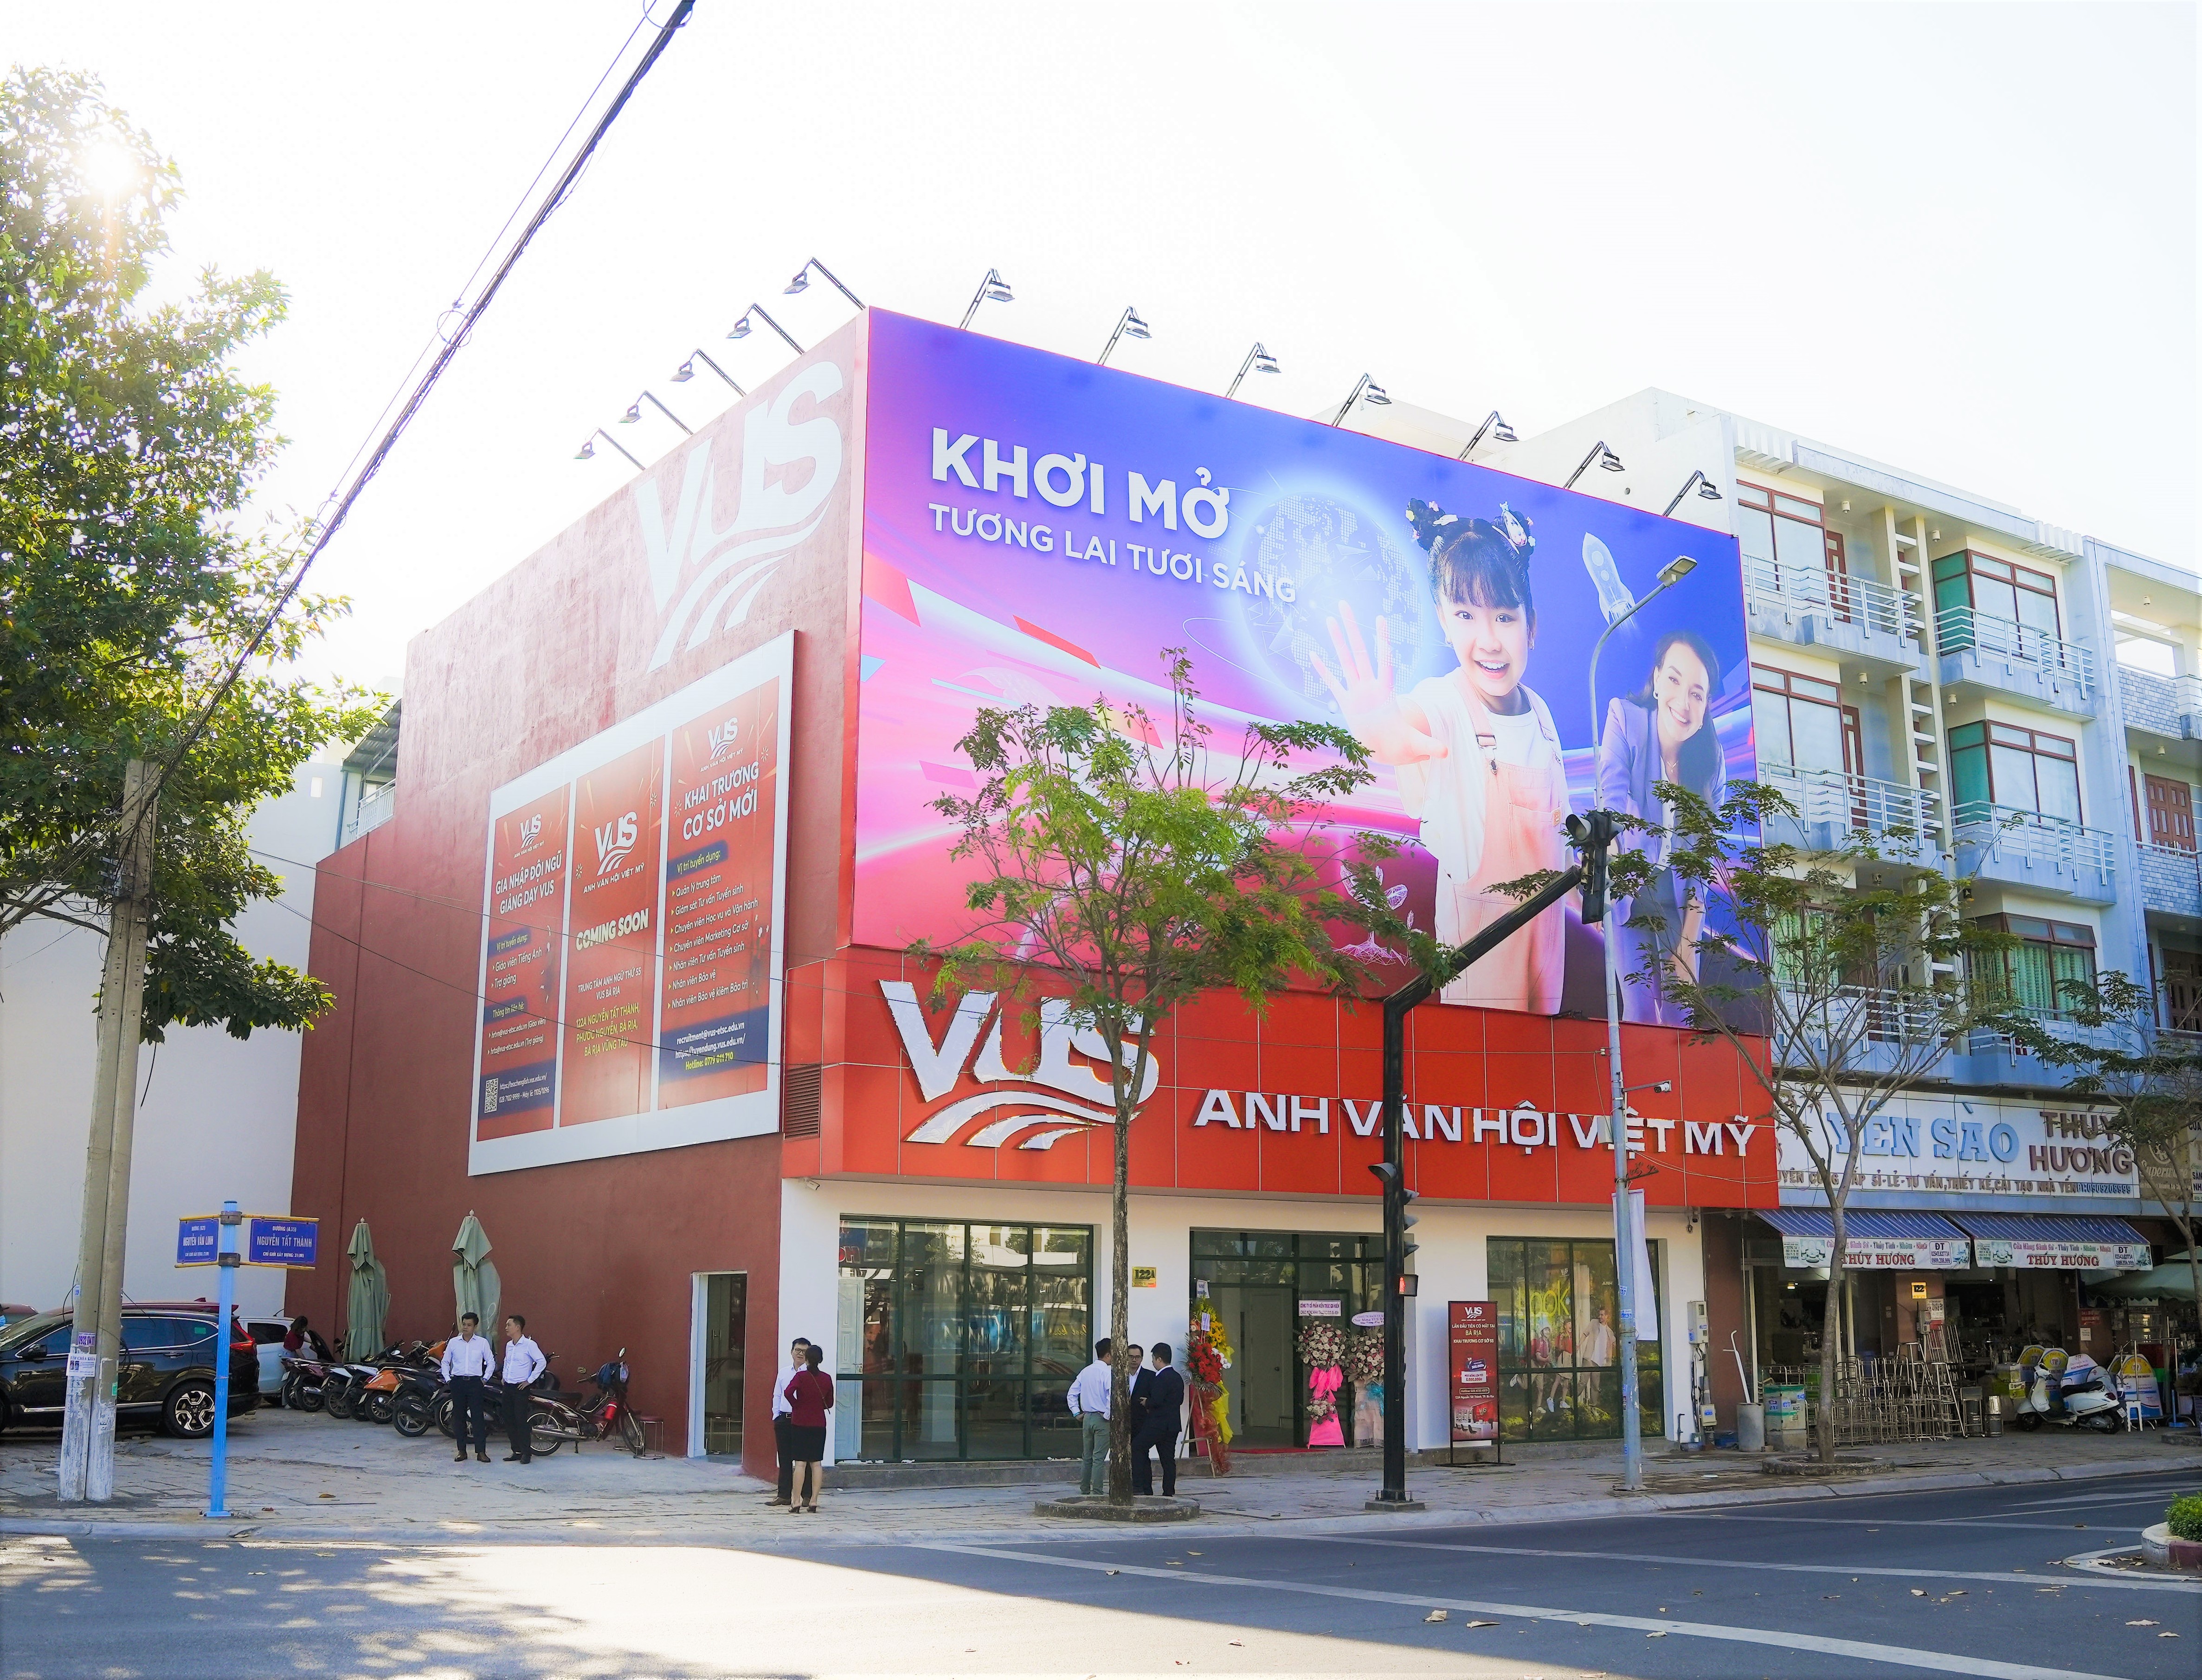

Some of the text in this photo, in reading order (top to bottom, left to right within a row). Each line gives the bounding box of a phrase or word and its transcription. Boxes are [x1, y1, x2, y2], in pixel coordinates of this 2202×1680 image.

[635, 360, 843, 618] VUS
[932, 426, 1230, 540] KHƠI MỞ
[928, 502, 1297, 603] TƯƠNG LAI TƯƠI SÁNG
[708, 717, 738, 752] VUS
[684, 761, 759, 810] KHAI TRƯƠNG
[683, 785, 757, 840] CƠ SỞ MỚI
[594, 811, 638, 863] VUS
[496, 850, 562, 895] GIA NHẬP ĐỘI NGŨ
[677, 864, 682, 874] Vị
[690, 854, 704, 869] tuyển
[706, 850, 721, 863] dụng:
[583, 862, 644, 894] ANH VĂN HỘI VIỆT MỸ
[676, 875, 721, 897] Quản lý trung tâm
[500, 880, 554, 914] GIẢNG DẠY VUS
[675, 903, 689, 915] Giám
[698, 897, 705, 906] Tư
[706, 894, 715, 904] vấn
[716, 887, 731, 901] Tuyển
[732, 883, 743, 895] sinh
[576, 908, 649, 951] COMING SOON
[675, 898, 758, 934] Chuyên viên Học vụ và Vận hành
[496, 934, 528, 952] Vị tuyển dụng:
[674, 920, 748, 953] Chuyên viên Marketing Cơ sở
[495, 946, 542, 972] Giáo viên Tiếng Anh
[673, 941, 745, 971] Nhân viên Tư vấn Tuyển sinh
[503, 974, 516, 987] giảng
[578, 966, 641, 993] TRUNG TÂM ANH NGỮ THỨ 55
[596, 991, 605, 1000] VUS
[606, 986, 612, 997] BÀ
[673, 969, 716, 990] Nhân viên Bảo vệ
[672, 998, 685, 1009] Nhân
[686, 994, 697, 1005] viên
[698, 991, 708, 1001] Bảo
[709, 988, 715, 1000] vệ
[716, 985, 729, 996] kiêm
[730, 982, 740, 992] Bảo
[493, 1009, 504, 1018] Thông
[576, 1003, 639, 1028] 122A NGUYỄN TẤT THÀNH,
[577, 1019, 638, 1043] PHƯỚC NGUYỄN, BÀ RỊA,
[676, 1022, 745, 1045] recruitment@vus-etsc.edu.vn
[879, 979, 1159, 1107] VUS
[585, 1045, 591, 1056] BÀ
[602, 1039, 617, 1052] VŨNG
[618, 1036, 628, 1048] TÀU
[685, 1056, 715, 1070] Hotline: 0779
[1194, 1089, 1756, 1156] ANH HỘI MỸ
[1931, 1102, 2019, 1162] SÀO
[2029, 1146, 2132, 1174] HƯƠNG
[257, 1234, 312, 1247] NGUYỄN TẤT THÀNH
[1876, 1252, 1915, 1265] HƯƠNG
[2027, 1251, 2099, 1266] THÚY HƯƠNG
[1134, 1269, 1155, 1280] 122A
[1465, 1307, 1482, 1316] VUS
